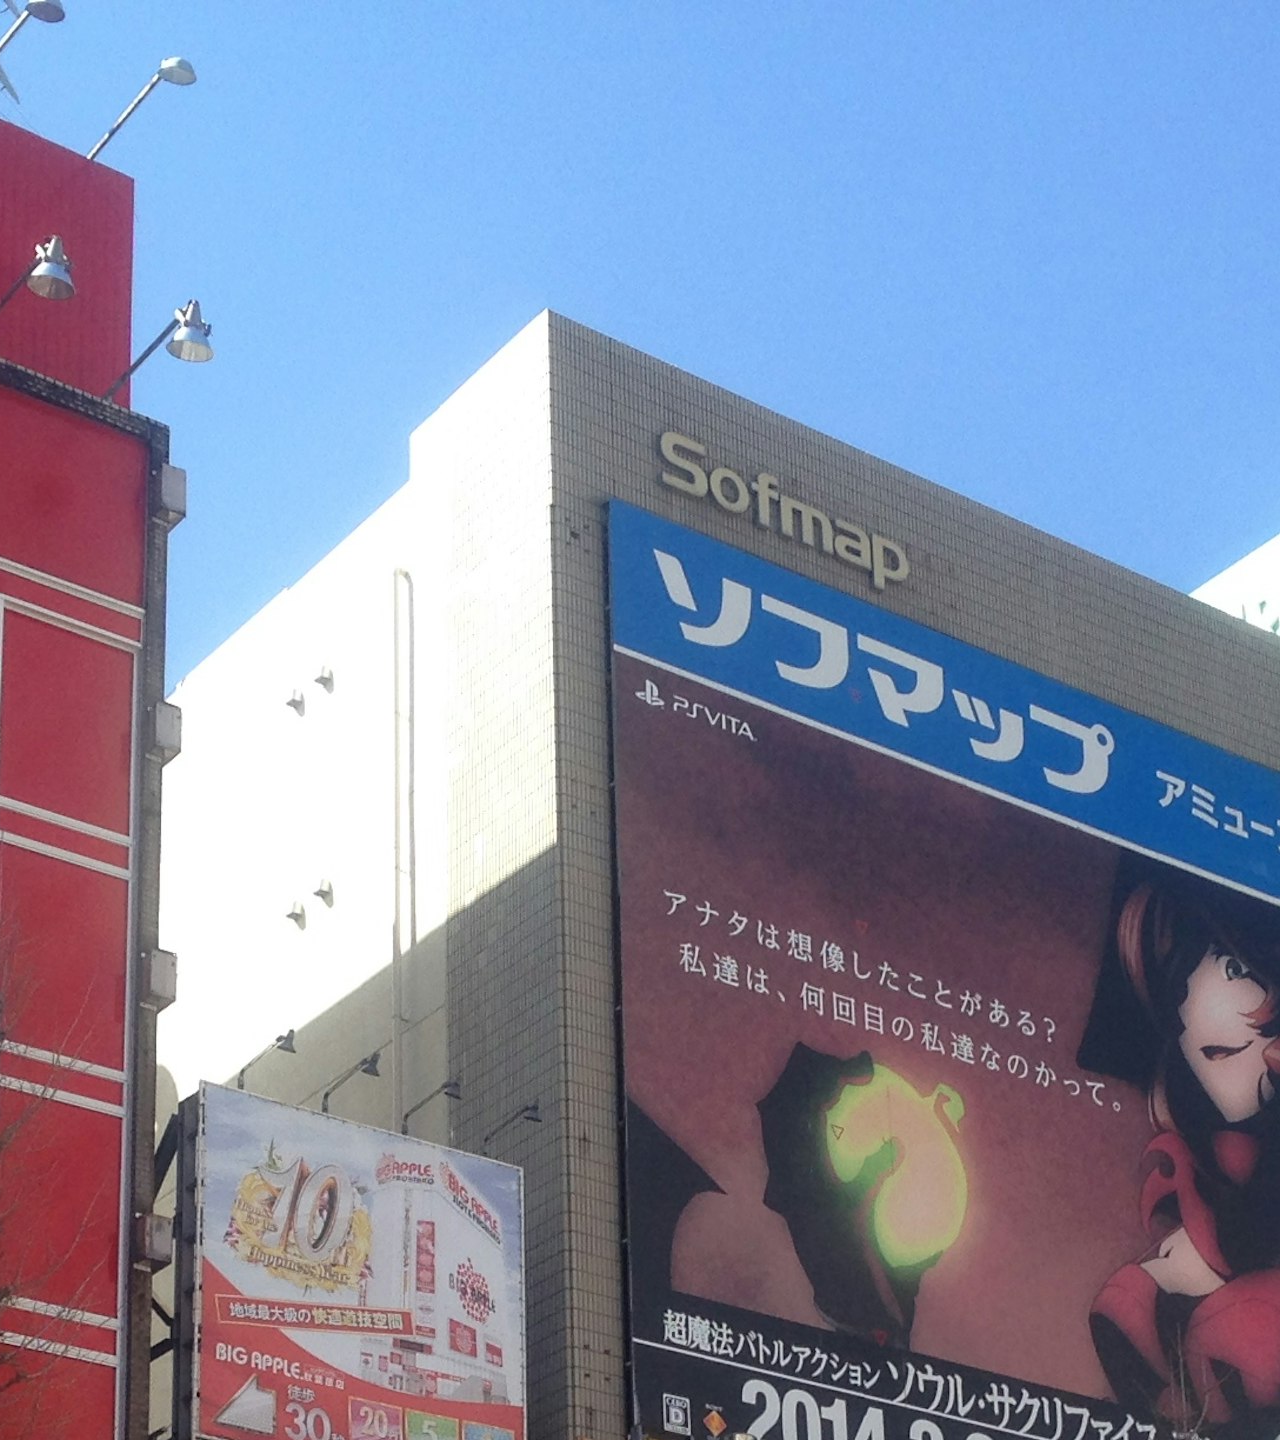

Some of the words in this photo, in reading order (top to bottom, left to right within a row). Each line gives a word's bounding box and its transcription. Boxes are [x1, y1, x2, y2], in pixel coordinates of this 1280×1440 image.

[660, 431, 911, 590] Sofmap
[653, 548, 1116, 795] ソフマップ
[678, 941, 1123, 1114] 私達は、何回目の私達なのかって。
[215, 1342, 248, 1365] BIG
[662, 1309, 880, 1390] 超魔法バトルアクション
